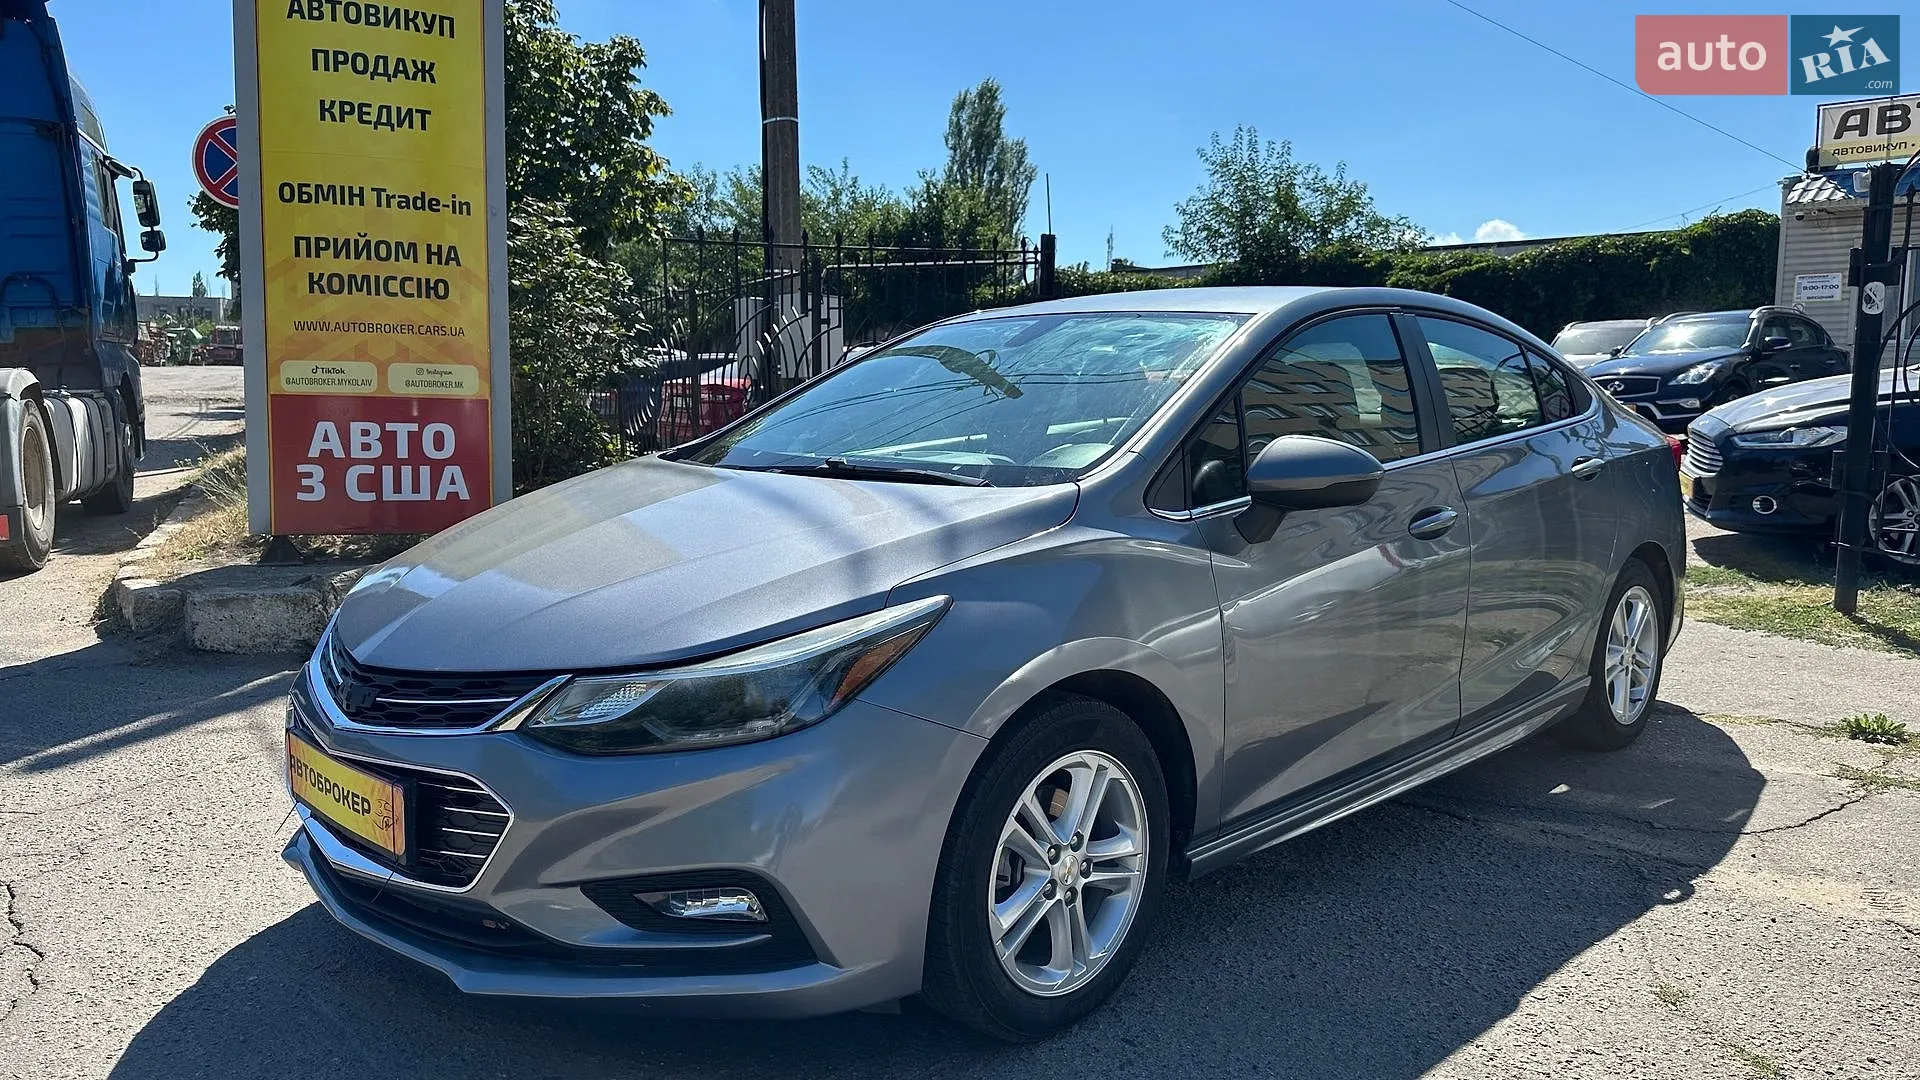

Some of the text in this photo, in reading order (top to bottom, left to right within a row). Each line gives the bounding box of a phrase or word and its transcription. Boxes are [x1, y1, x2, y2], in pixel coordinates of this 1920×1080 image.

[287, 0, 455, 39] АВТОВИКУП
[311, 48, 437, 84] ПРОДАЖ
[319, 99, 432, 132] КРЕДИТ
[1833, 102, 1920, 140] АВ
[1831, 141, 1908, 157] АВТОВИКУП
[278, 182, 472, 216] ОБМІН Trade-in
[293, 232, 462, 267] ПРИЙОМ НА
[308, 272, 450, 301] КОМІССІЮ
[293, 319, 466, 337] WWW.AUTOBROKER.CARS.UA
[320, 367, 346, 375] TikTok
[307, 421, 456, 460] АВТО
[296, 464, 471, 502] З США
[290, 754, 371, 816] АВТОБРОКЕР
